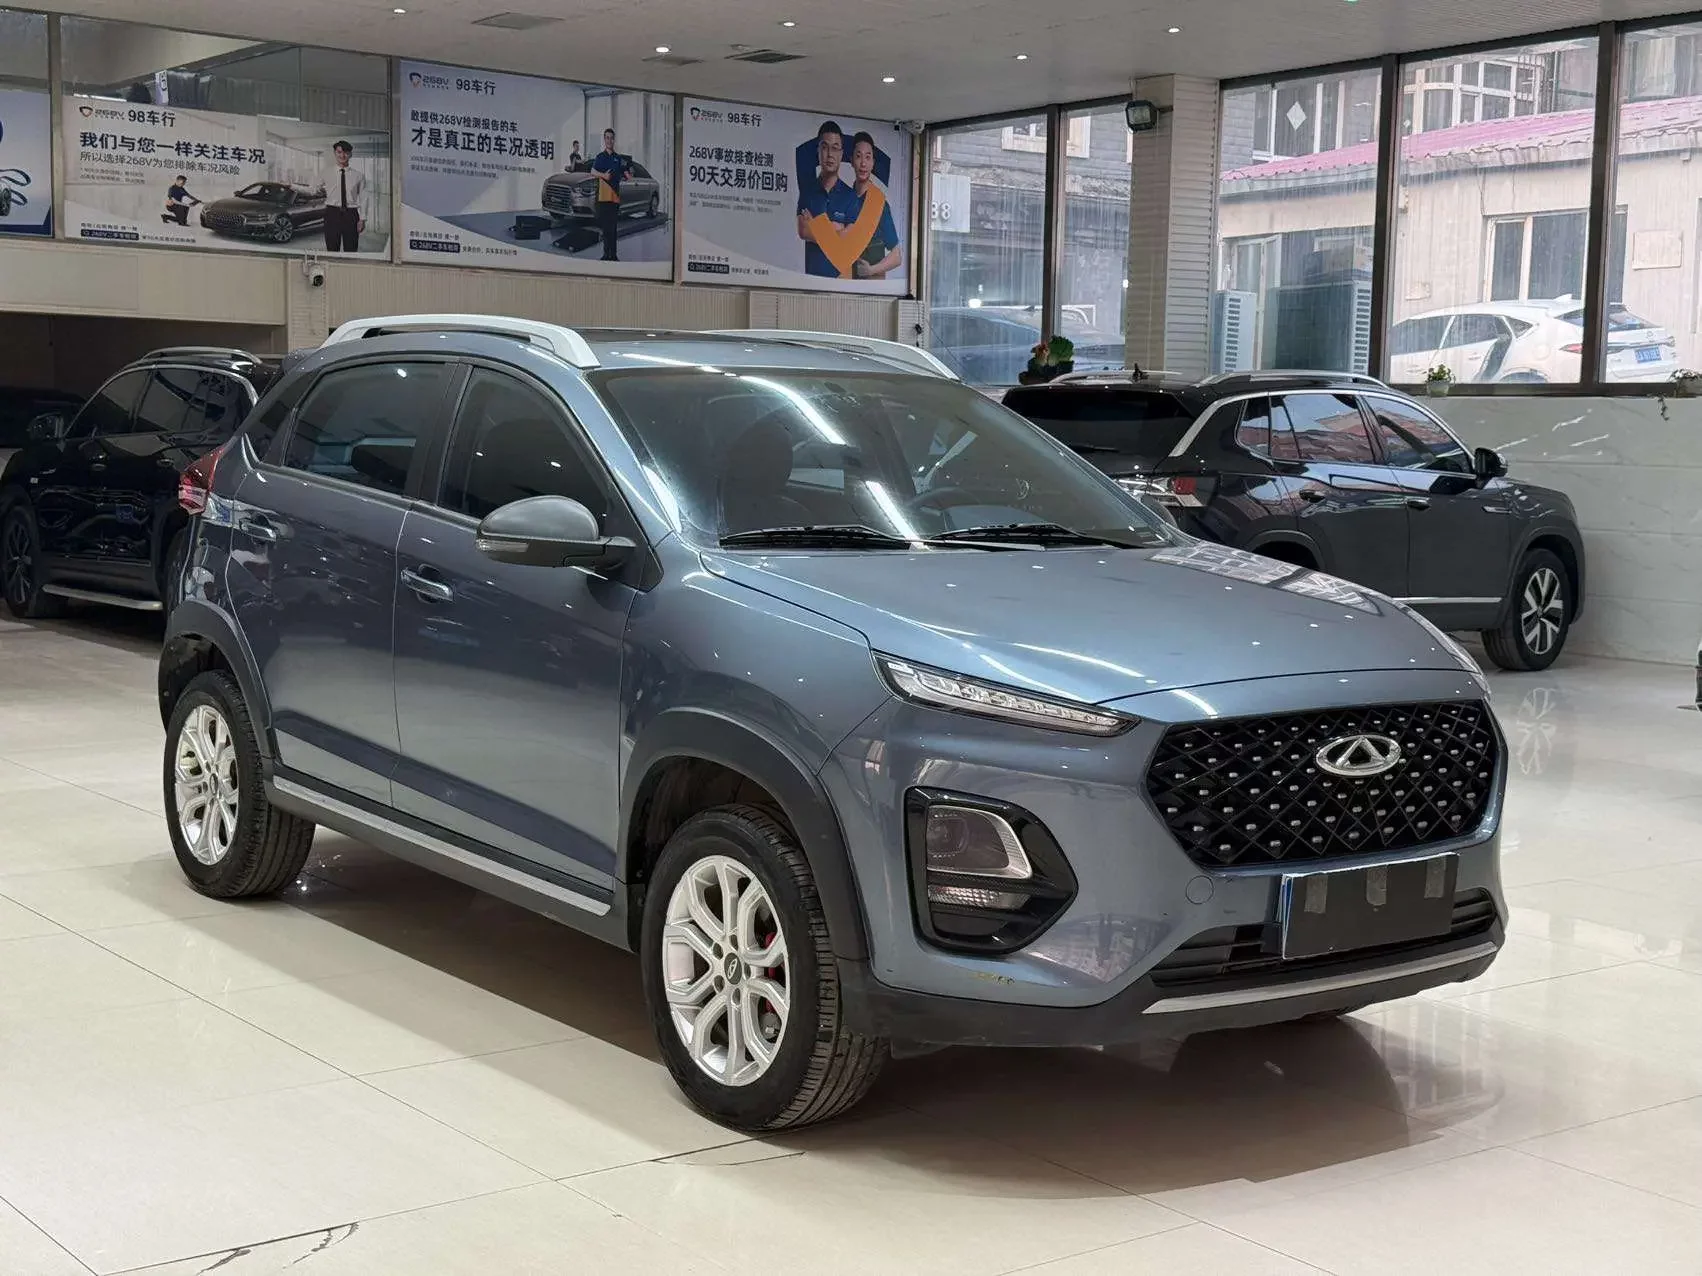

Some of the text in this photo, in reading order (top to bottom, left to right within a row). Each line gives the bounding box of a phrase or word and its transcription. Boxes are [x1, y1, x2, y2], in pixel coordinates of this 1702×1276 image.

[455, 78, 496, 95] 98车行
[128, 109, 176, 127] 98车行
[410, 109, 518, 133] 敢提供268V检测报告的车
[727, 112, 762, 127] 98车行
[79, 131, 266, 165] 我们与您一样关注车况
[411, 126, 555, 161] 才是真正的车况透明
[80, 151, 241, 175] 所以选择268V为您排除车况风险
[689, 145, 774, 168] 268V事故排查检测
[689, 165, 788, 192] 90天交易价回购
